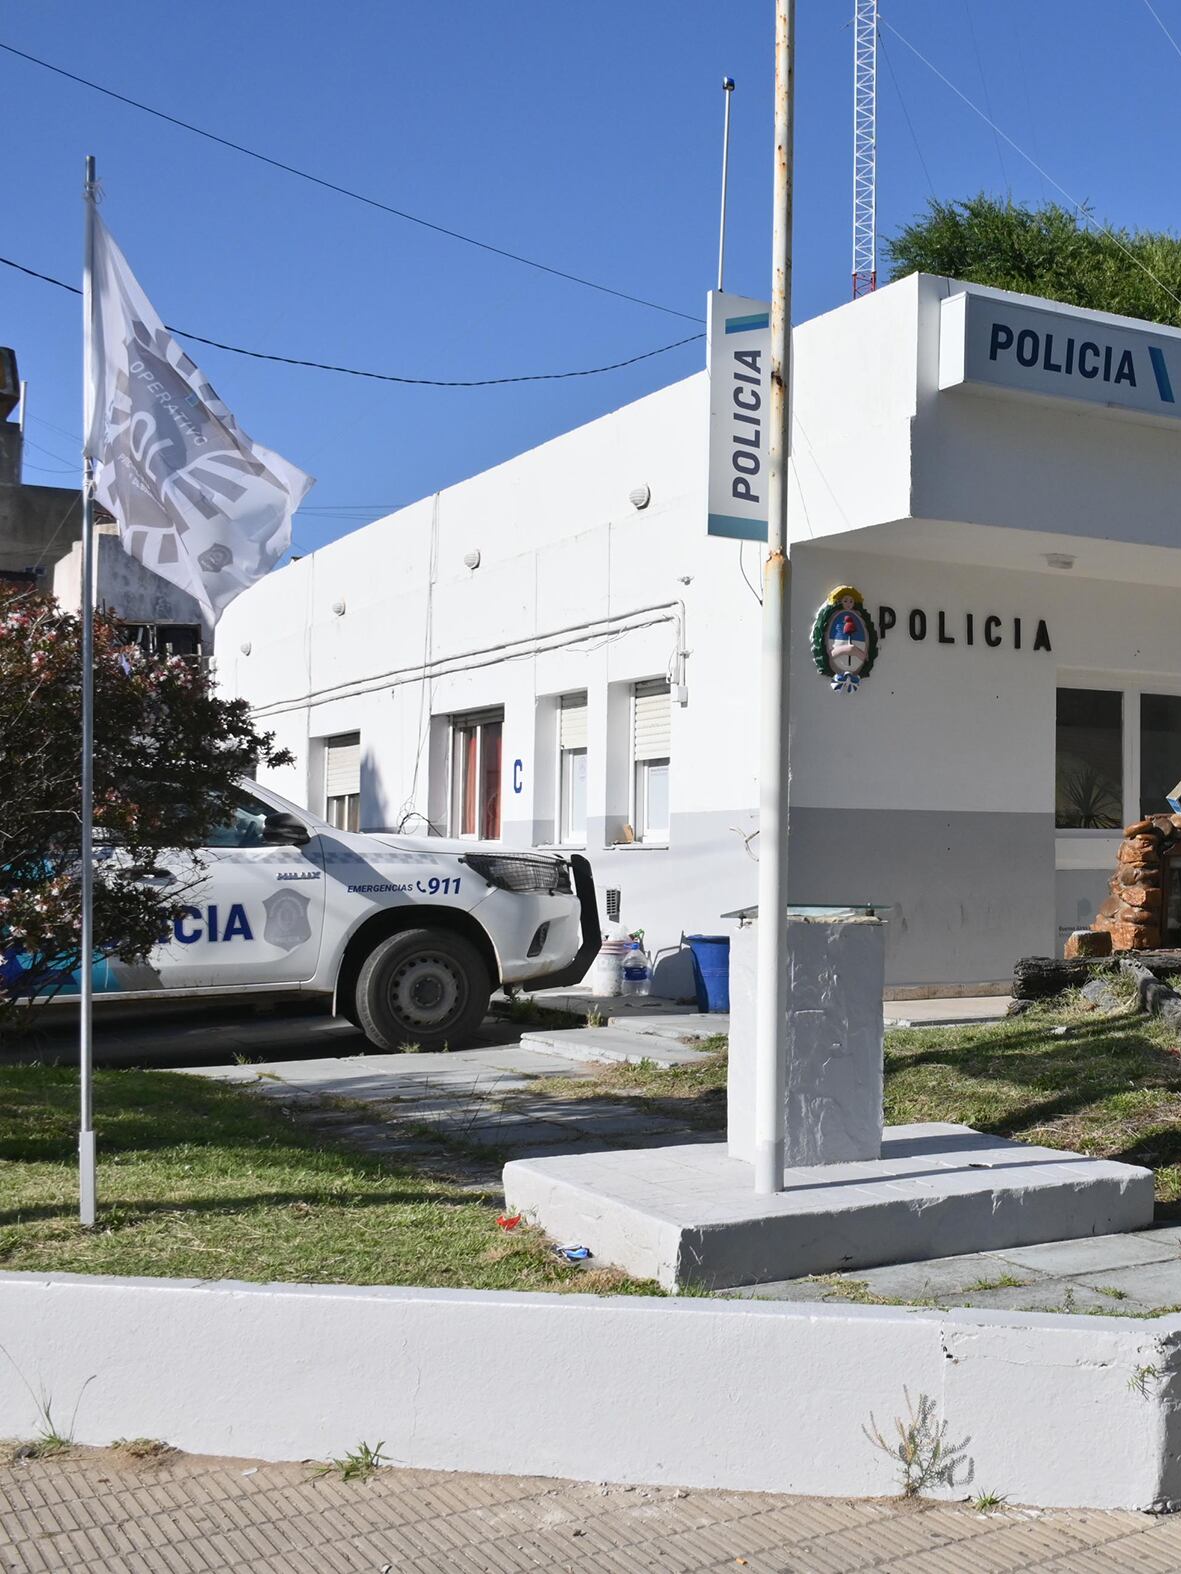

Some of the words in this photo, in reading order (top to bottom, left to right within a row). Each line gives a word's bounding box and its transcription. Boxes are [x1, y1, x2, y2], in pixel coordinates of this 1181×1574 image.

[989, 323, 1137, 387] POLICIA
[129, 360, 208, 446] OPERATIVO
[732, 350, 761, 503] POLICIA
[879, 606, 1052, 652] POLICIA
[513, 759, 523, 794] C
[347, 884, 413, 893] EMERGENCIAS
[428, 877, 461, 895] 911
